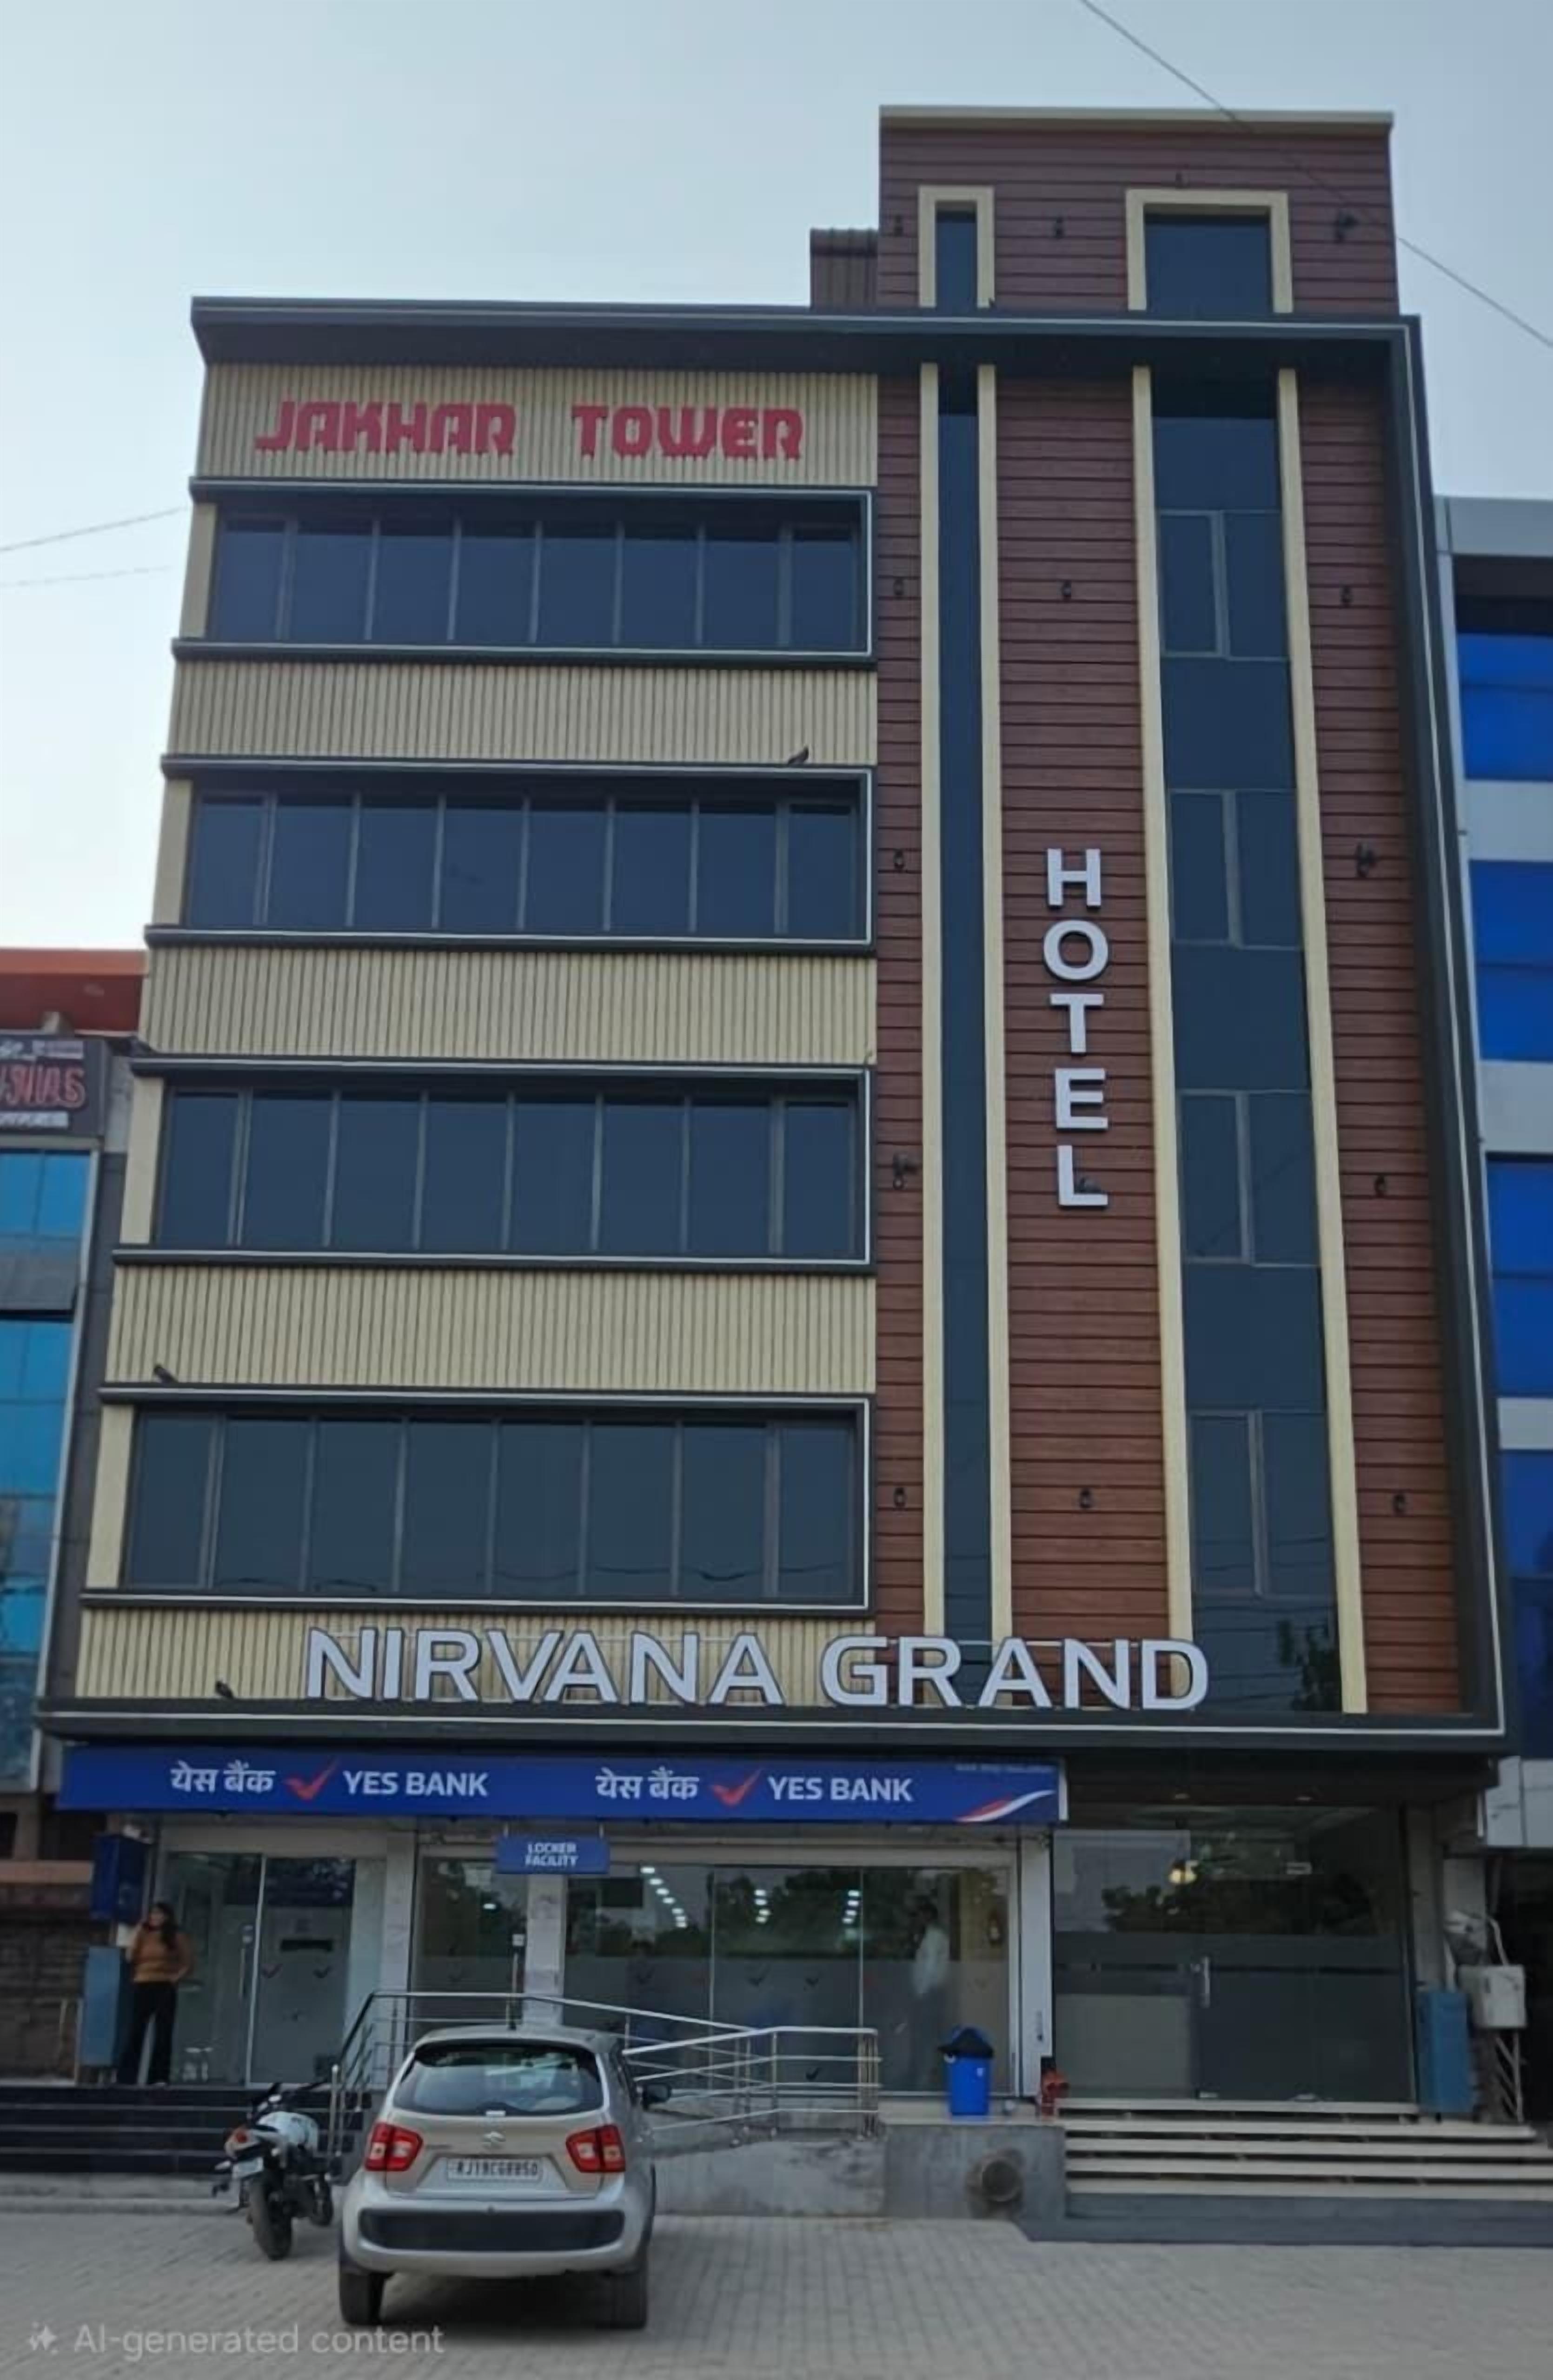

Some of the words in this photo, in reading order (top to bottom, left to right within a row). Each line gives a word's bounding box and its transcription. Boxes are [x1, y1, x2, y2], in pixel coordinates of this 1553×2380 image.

[255, 401, 517, 454] JAKHAR
[571, 405, 803, 460] TOWER
[1043, 848, 1109, 1207] HOTEL
[306, 1627, 786, 1705] NIRVANA
[820, 1635, 1209, 1710] GRAND
[170, 1759, 219, 1792] येस
[223, 1759, 277, 1794] बैंक
[343, 1770, 398, 1795] YES
[405, 1771, 488, 1797] BANK
[595, 1767, 644, 1799] येस
[648, 1766, 700, 1799] बैंक
[768, 1776, 823, 1800] YES
[830, 1778, 913, 1802] BANK
[525, 1854, 578, 1867] FACILITY
